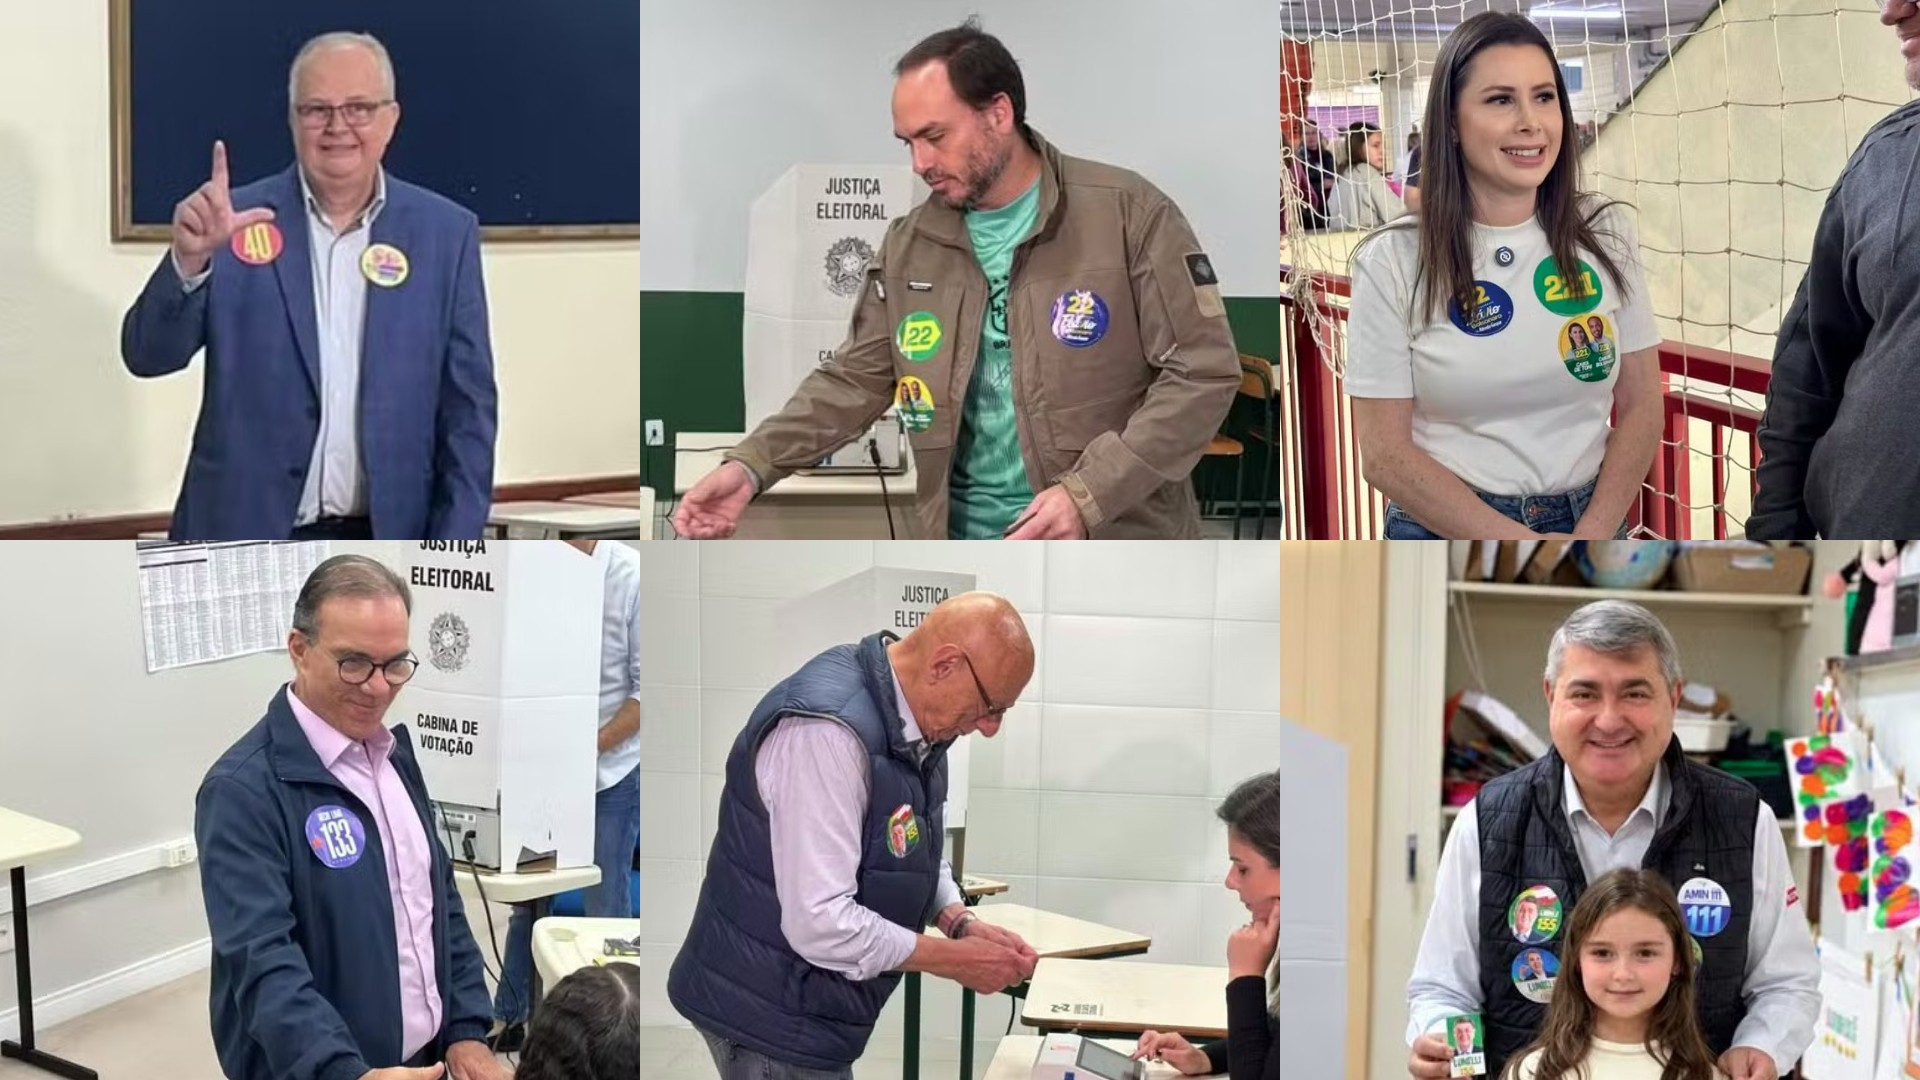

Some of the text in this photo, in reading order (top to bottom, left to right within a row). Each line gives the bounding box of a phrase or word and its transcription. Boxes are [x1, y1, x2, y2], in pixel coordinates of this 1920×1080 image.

[825, 178, 881, 199] JUSTIÇA
[817, 203, 888, 220] ELEITORAL
[244, 223, 272, 261] 40
[907, 326, 932, 346] 22
[420, 540, 486, 559] JUSTIÇA
[411, 566, 494, 592] ELEITORAL
[895, 610, 930, 627] ELEIT
[417, 713, 479, 736] CABINA DE
[420, 734, 473, 757] VOTAÇÃO
[319, 818, 357, 859] 133
[1685, 889, 1709, 900] AMIN
[1687, 905, 1722, 934] 111
